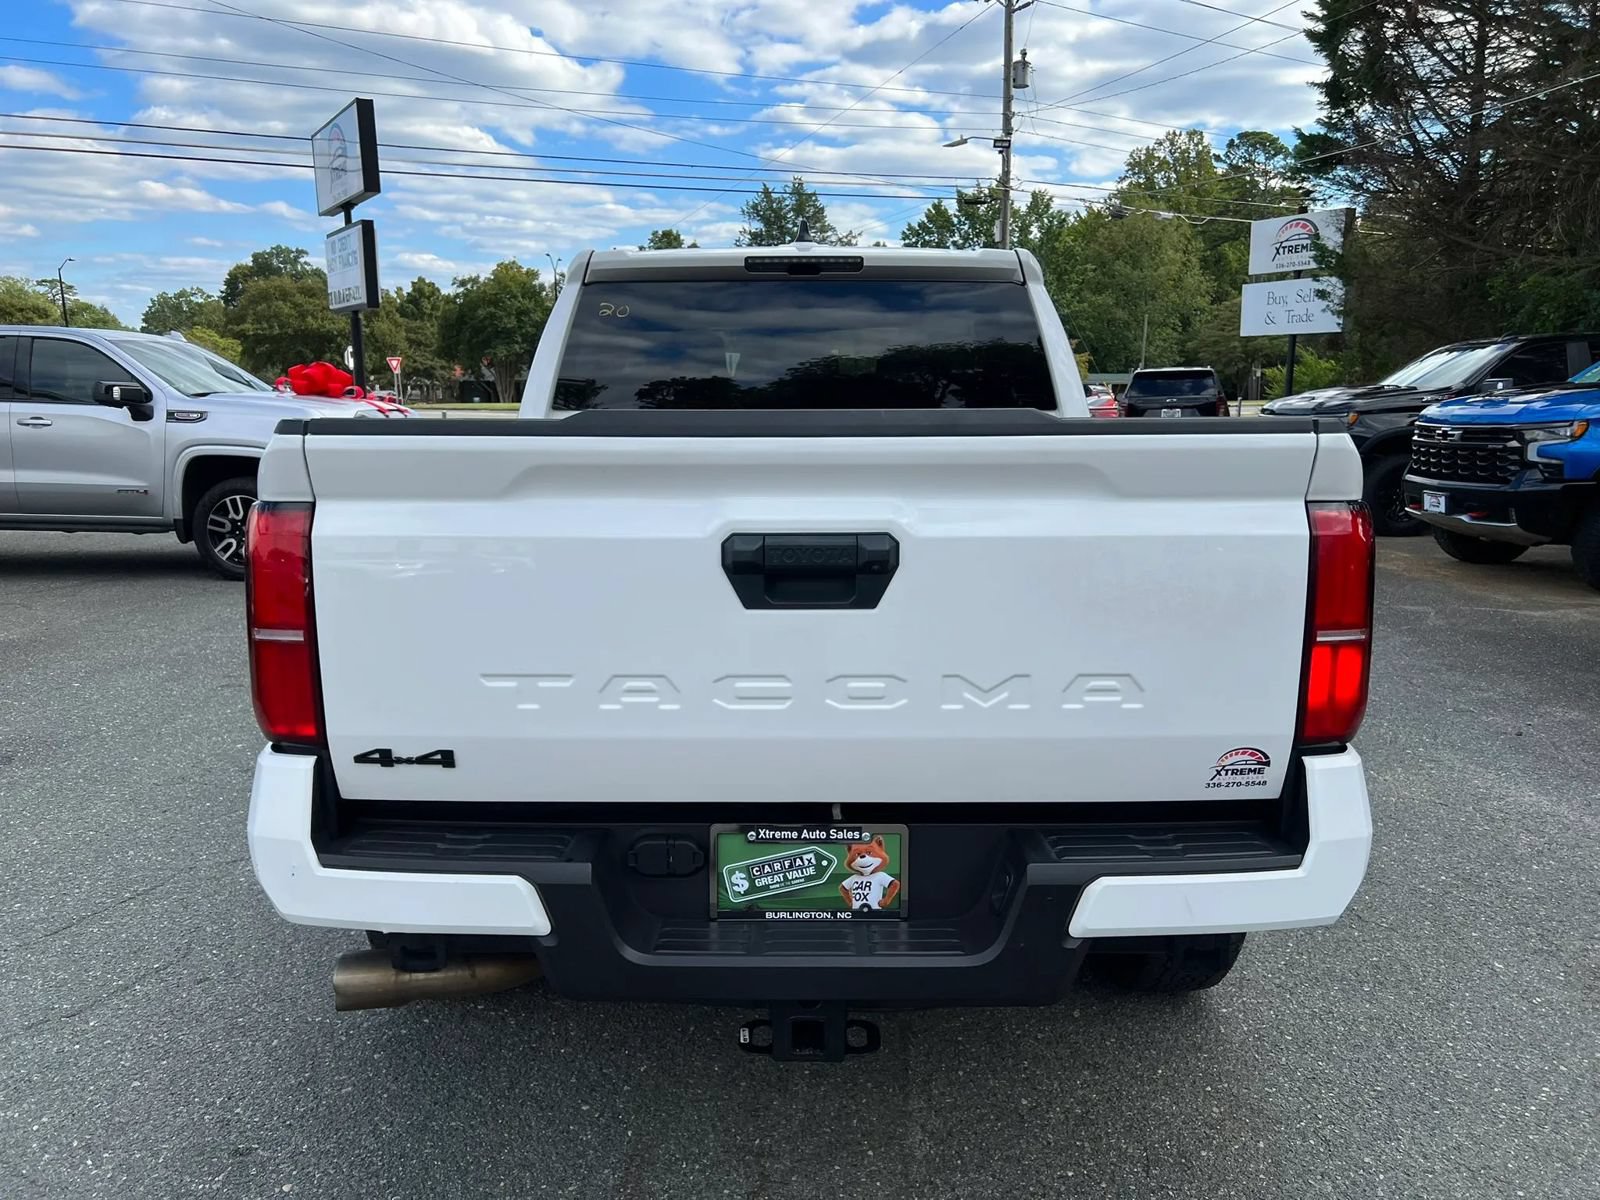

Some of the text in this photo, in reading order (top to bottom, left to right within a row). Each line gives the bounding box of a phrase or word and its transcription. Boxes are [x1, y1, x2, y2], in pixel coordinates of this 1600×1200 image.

[1267, 287, 1315, 307] Buy, Sell
[1264, 308, 1314, 326] & Trade
[768, 547, 854, 563] TOYOTA
[480, 673, 1145, 710] TACOMA
[1209, 767, 1266, 781] XTREME
[1204, 780, 1268, 789] 336-270-5548
[758, 828, 860, 839] Xtreme Auto Sales
[751, 855, 815, 877] CARFAX
[755, 873, 785, 887] GREAT
[785, 866, 817, 880] VALUE
[852, 881, 872, 891] CAR
[765, 911, 853, 920] BURLINGTON, NC
